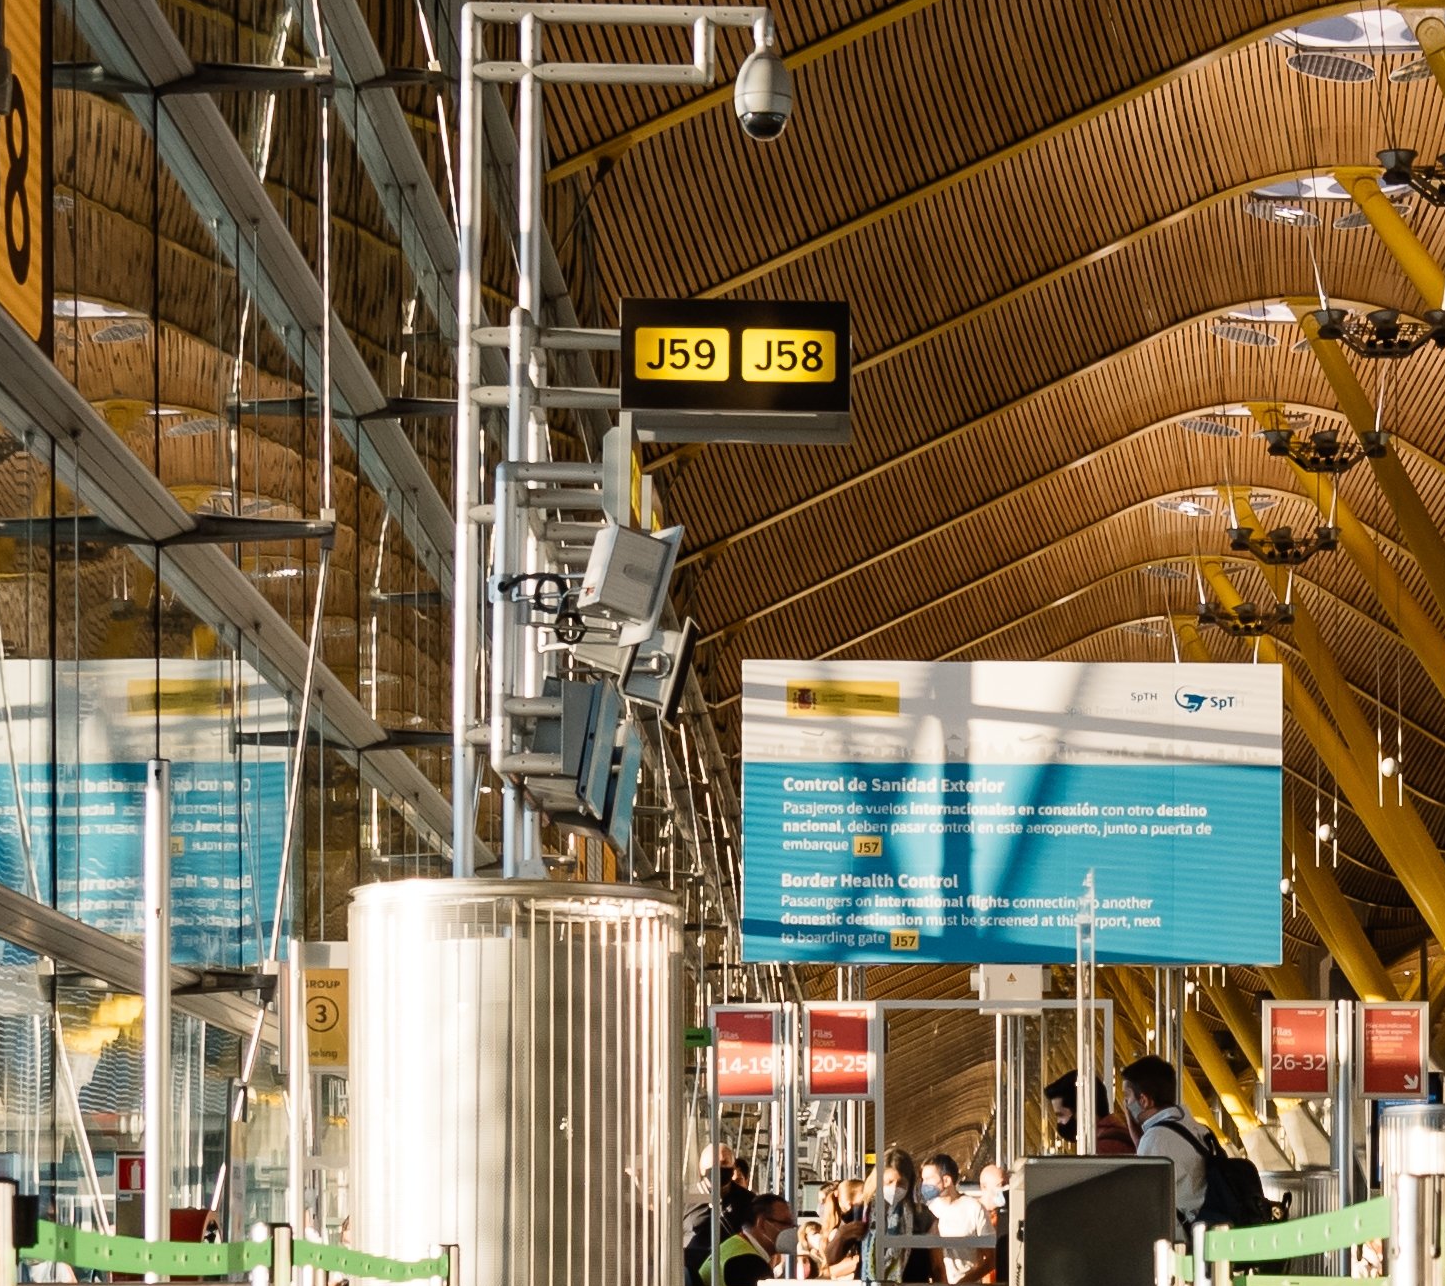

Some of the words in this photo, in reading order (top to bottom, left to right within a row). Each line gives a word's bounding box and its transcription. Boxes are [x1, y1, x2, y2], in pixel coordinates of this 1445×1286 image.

[646, 338, 715, 370] J59
[755, 340, 823, 372] J58
[1130, 692, 1158, 702] SpTH
[783, 777, 844, 793] Control
[848, 778, 867, 792] de
[872, 778, 937, 793] Sanidad
[941, 779, 1005, 794] Exterior
[783, 802, 844, 818] Pasajeros
[847, 803, 863, 815] de
[866, 803, 907, 815] vuelos
[910, 803, 1016, 816] internacionales
[1018, 806, 1035, 816] en
[1038, 802, 1099, 817] conexión
[1101, 805, 1125, 817] con
[1127, 805, 1154, 817] otro
[1157, 804, 1207, 817] destino
[783, 821, 845, 835] nacional,
[848, 821, 888, 833] deben
[891, 824, 927, 836] pasar
[929, 821, 975, 834] control
[978, 824, 994, 834] en
[997, 823, 1023, 834] este
[1026, 823, 1101, 836] aeropuerto,
[1103, 823, 1138, 838] junto
[1140, 825, 1148, 835] a
[1151, 824, 1193, 837] puerta
[1196, 823, 1212, 835] de
[783, 839, 849, 853] embarque
[857, 842, 879, 854] J57
[781, 873, 837, 888] Border
[841, 873, 894, 888] Health
[898, 874, 958, 889] Control
[781, 895, 853, 910] Passengers
[855, 897, 872, 907] on
[875, 895, 964, 908] international
[966, 895, 1010, 911] flights
[1102, 897, 1153, 910] another
[781, 913, 843, 927] domestic
[846, 913, 924, 927] destination
[926, 916, 958, 927] must
[961, 914, 977, 927] be
[980, 915, 1038, 928] screened
[1041, 917, 1054, 927] at
[1134, 917, 1161, 928] next
[781, 933, 794, 944] to
[797, 933, 855, 947] boarding
[858, 934, 886, 947] gate
[894, 935, 916, 948] J57
[315, 1004, 327, 1024] 3
[813, 1029, 833, 1039] Filas
[1273, 1027, 1293, 1036] Filas
[718, 1057, 773, 1075] 14-19
[812, 1055, 868, 1073] 20-25
[1272, 1054, 1326, 1071] 26-32
